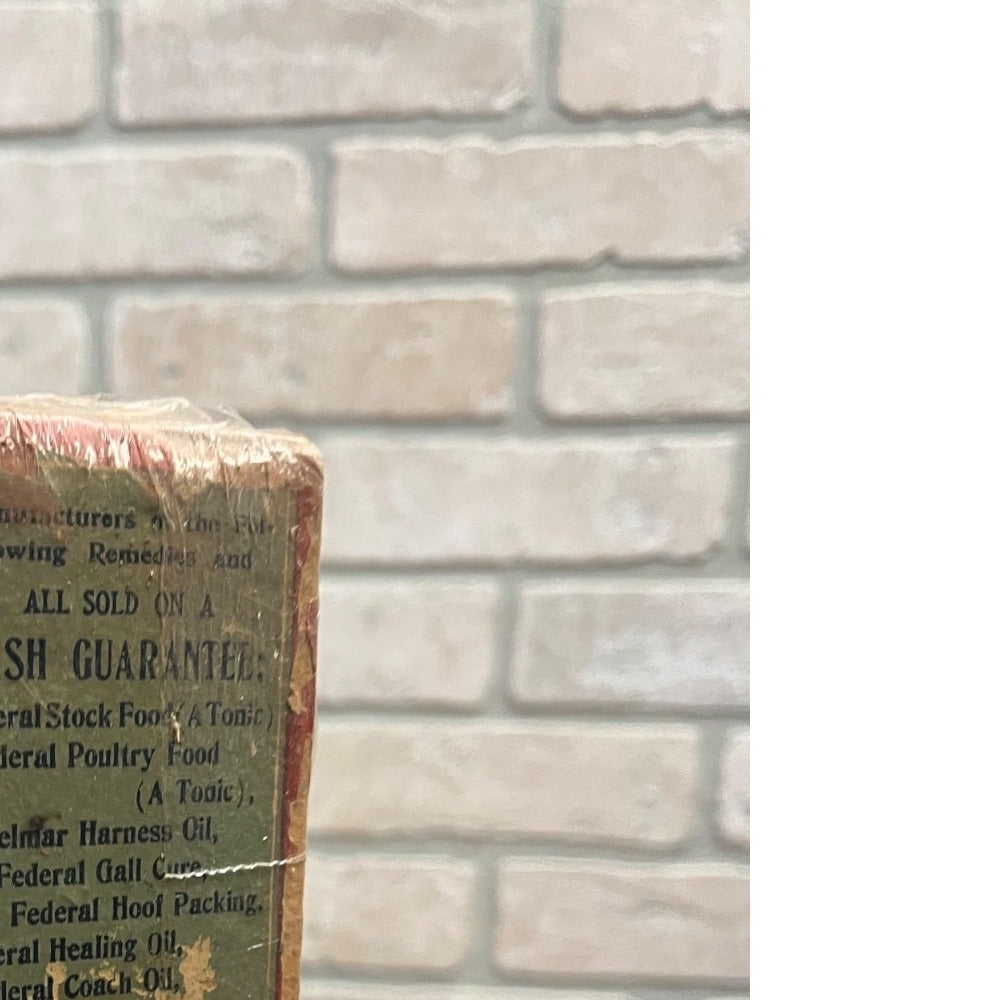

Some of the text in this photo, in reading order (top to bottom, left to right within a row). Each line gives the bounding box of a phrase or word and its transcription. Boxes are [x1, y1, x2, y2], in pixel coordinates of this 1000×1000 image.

[88, 541, 197, 567] Remedies
[213, 549, 252, 570] and
[23, 588, 215, 618] ALL SOLD ON A
[46, 702, 113, 729] Stock
[67, 740, 155, 772] Poultry
[167, 740, 220, 766] Food
[136, 780, 163, 812] (A
[79, 819, 173, 847] Harness
[182, 817, 217, 844] Oil,
[96, 857, 142, 882] Gall
[10, 899, 99, 927] Federal
[112, 895, 164, 924] Hoof
[50, 934, 138, 962] Healing
[64, 972, 132, 999] Coach
[143, 968, 180, 994] Oil,
